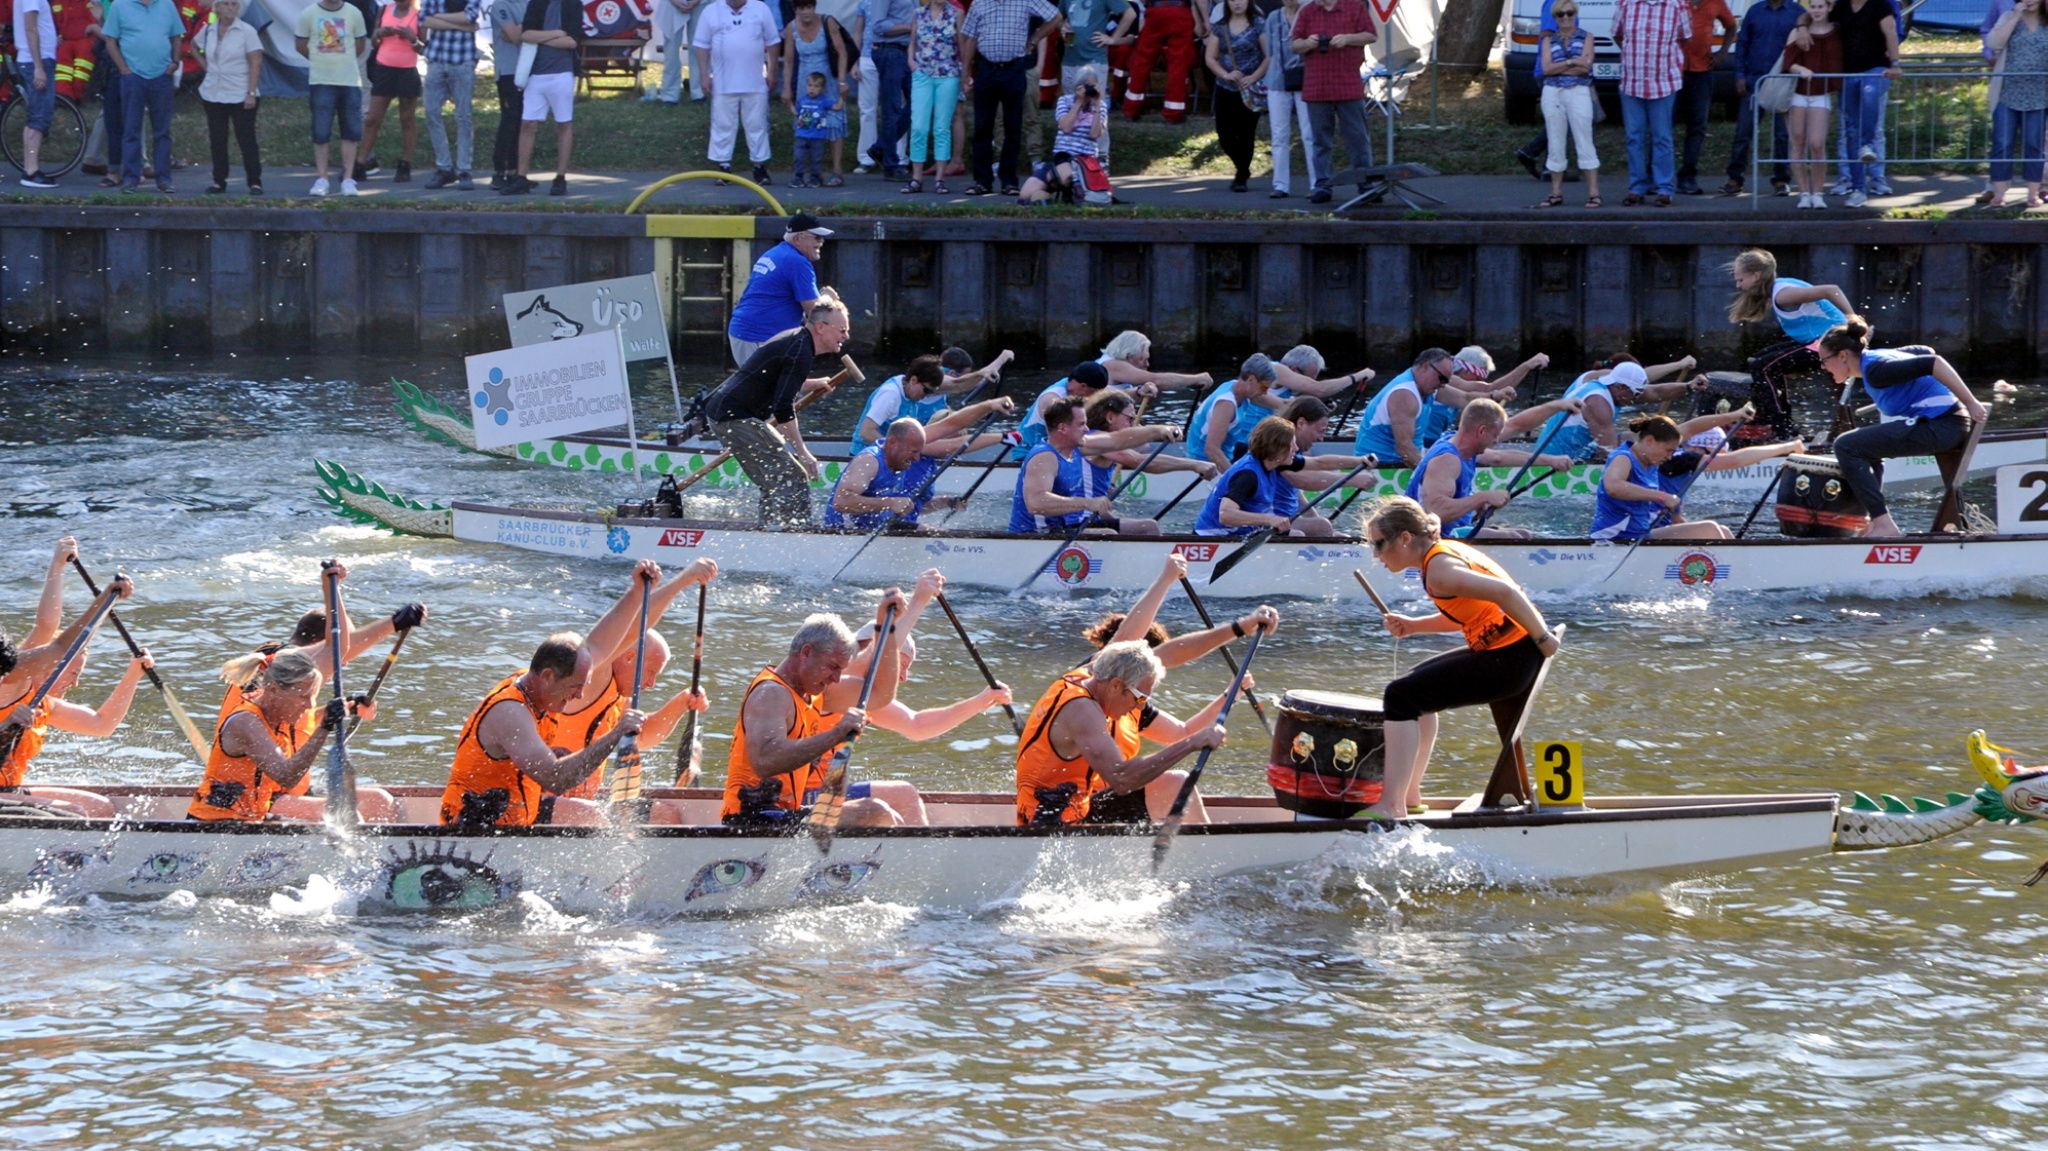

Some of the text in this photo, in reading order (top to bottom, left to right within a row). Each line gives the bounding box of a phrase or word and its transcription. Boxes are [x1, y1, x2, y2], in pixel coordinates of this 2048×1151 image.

[514, 360, 607, 392] IMMOBILIEN
[515, 385, 572, 410] GRUPPE
[518, 393, 626, 427] SAARBRÜCKEN
[2018, 470, 2048, 522] 2
[498, 519, 591, 536] SAARBRÜCKER
[497, 532, 590, 549] KANU-CLUB e.V.
[667, 531, 696, 546] VSE
[968, 546, 986, 554] VVS.
[1177, 545, 1210, 560] VSE
[1328, 550, 1341, 558] Die
[1875, 547, 1912, 562] VSE
[1544, 744, 1572, 801] 3
